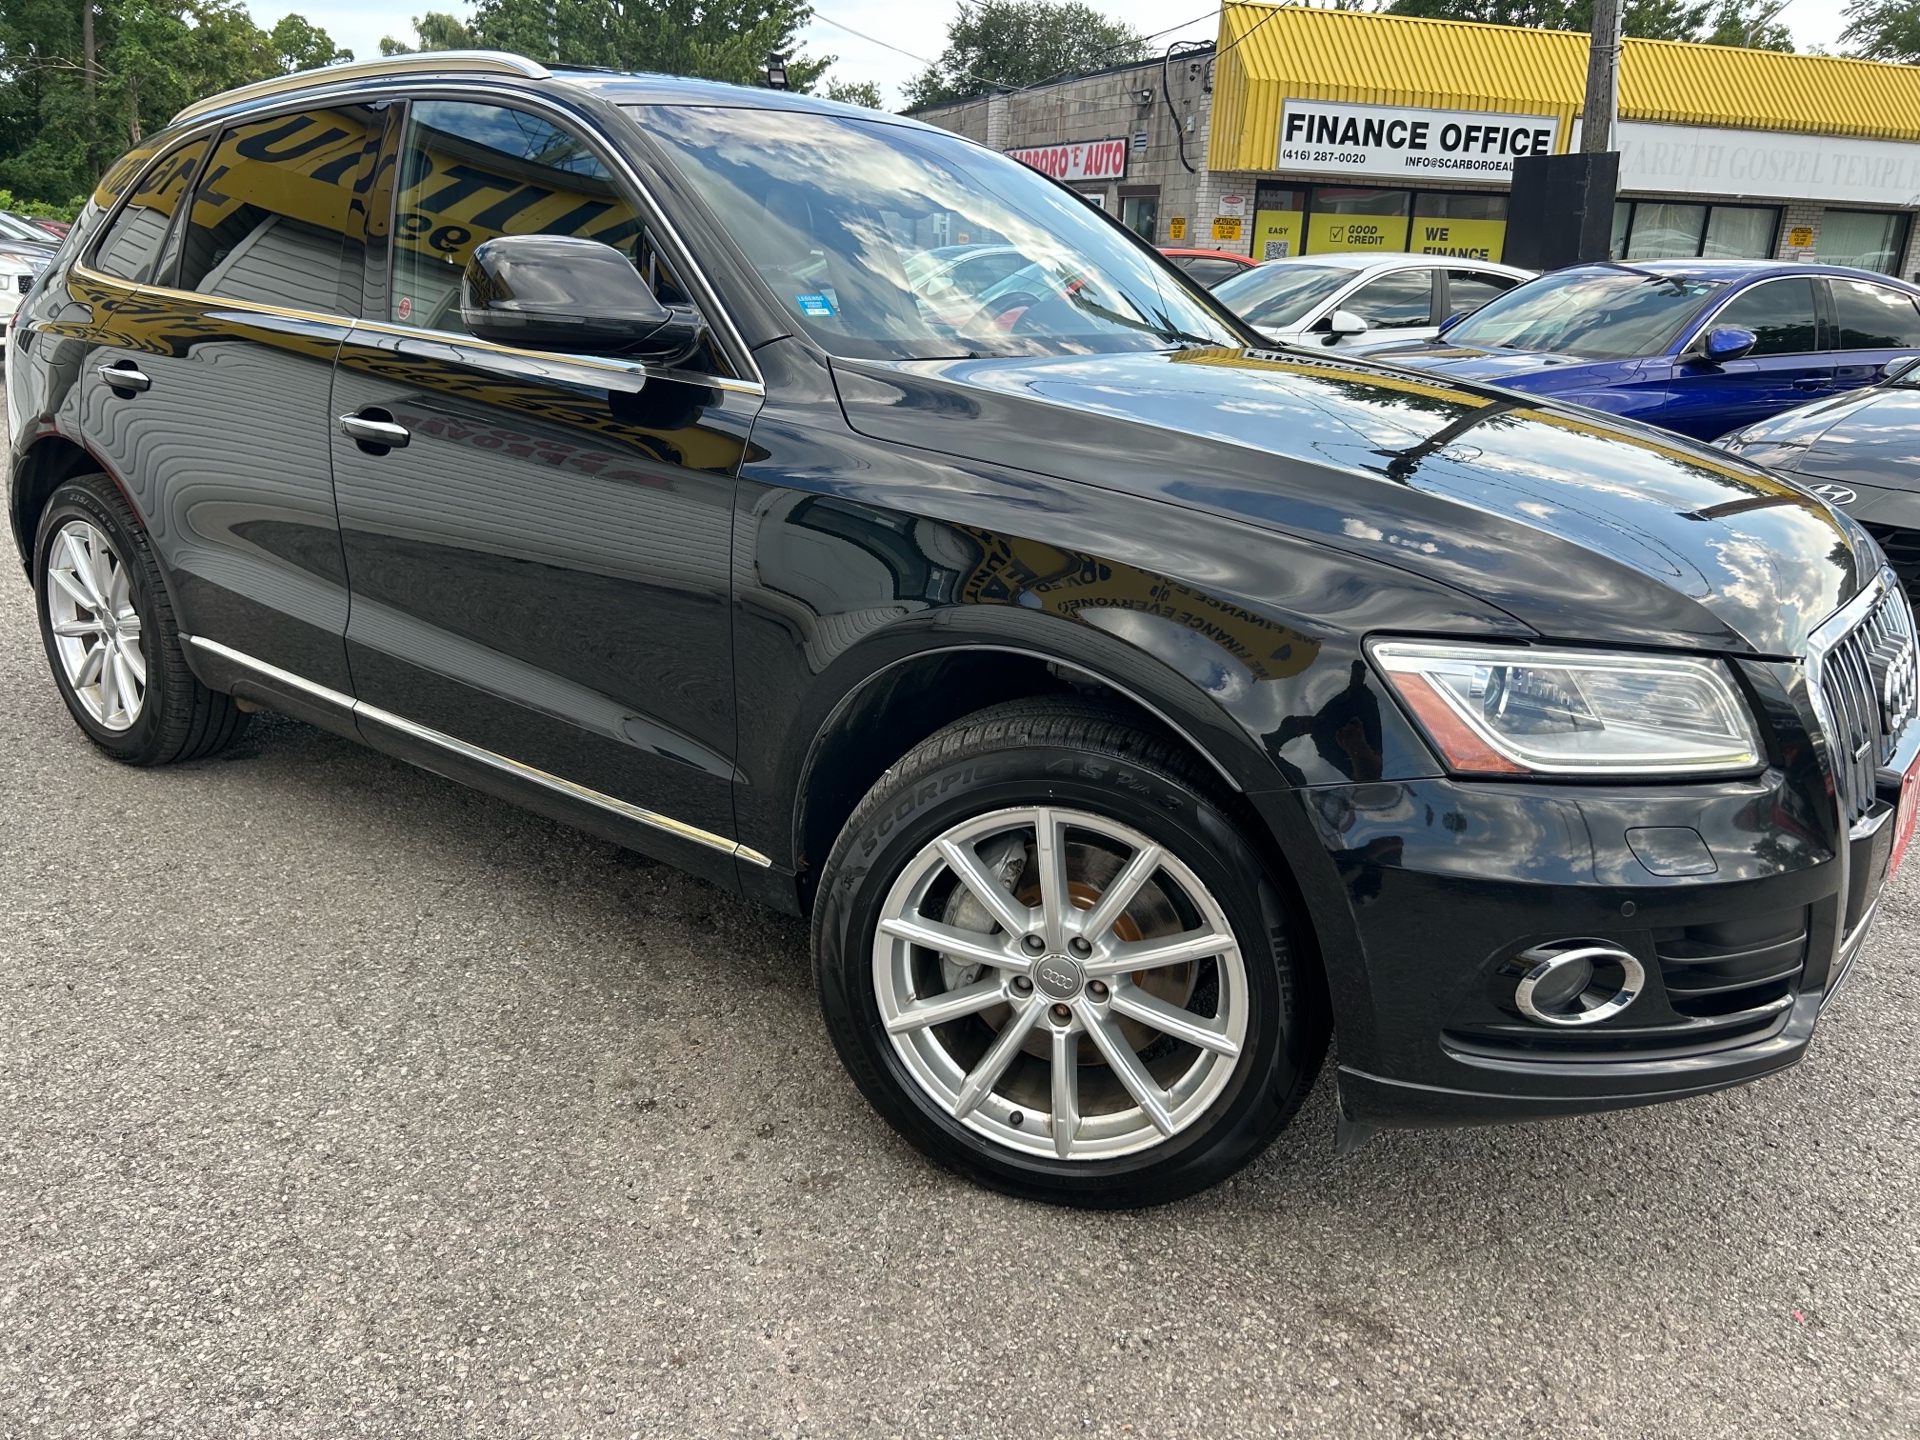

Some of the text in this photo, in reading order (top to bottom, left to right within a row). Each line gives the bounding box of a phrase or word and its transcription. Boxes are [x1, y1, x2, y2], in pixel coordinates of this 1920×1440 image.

[1285, 113, 1551, 156] FINANCE OFFICE
[1083, 141, 1123, 176] AUTO
[1283, 149, 1366, 164] (416) 287-0020
[1729, 147, 1824, 184] GOSPEL
[1268, 227, 1289, 235] EASY
[1348, 225, 1378, 235] GOOD
[1425, 227, 1449, 242] WE
[1347, 235, 1384, 245] CREDIT
